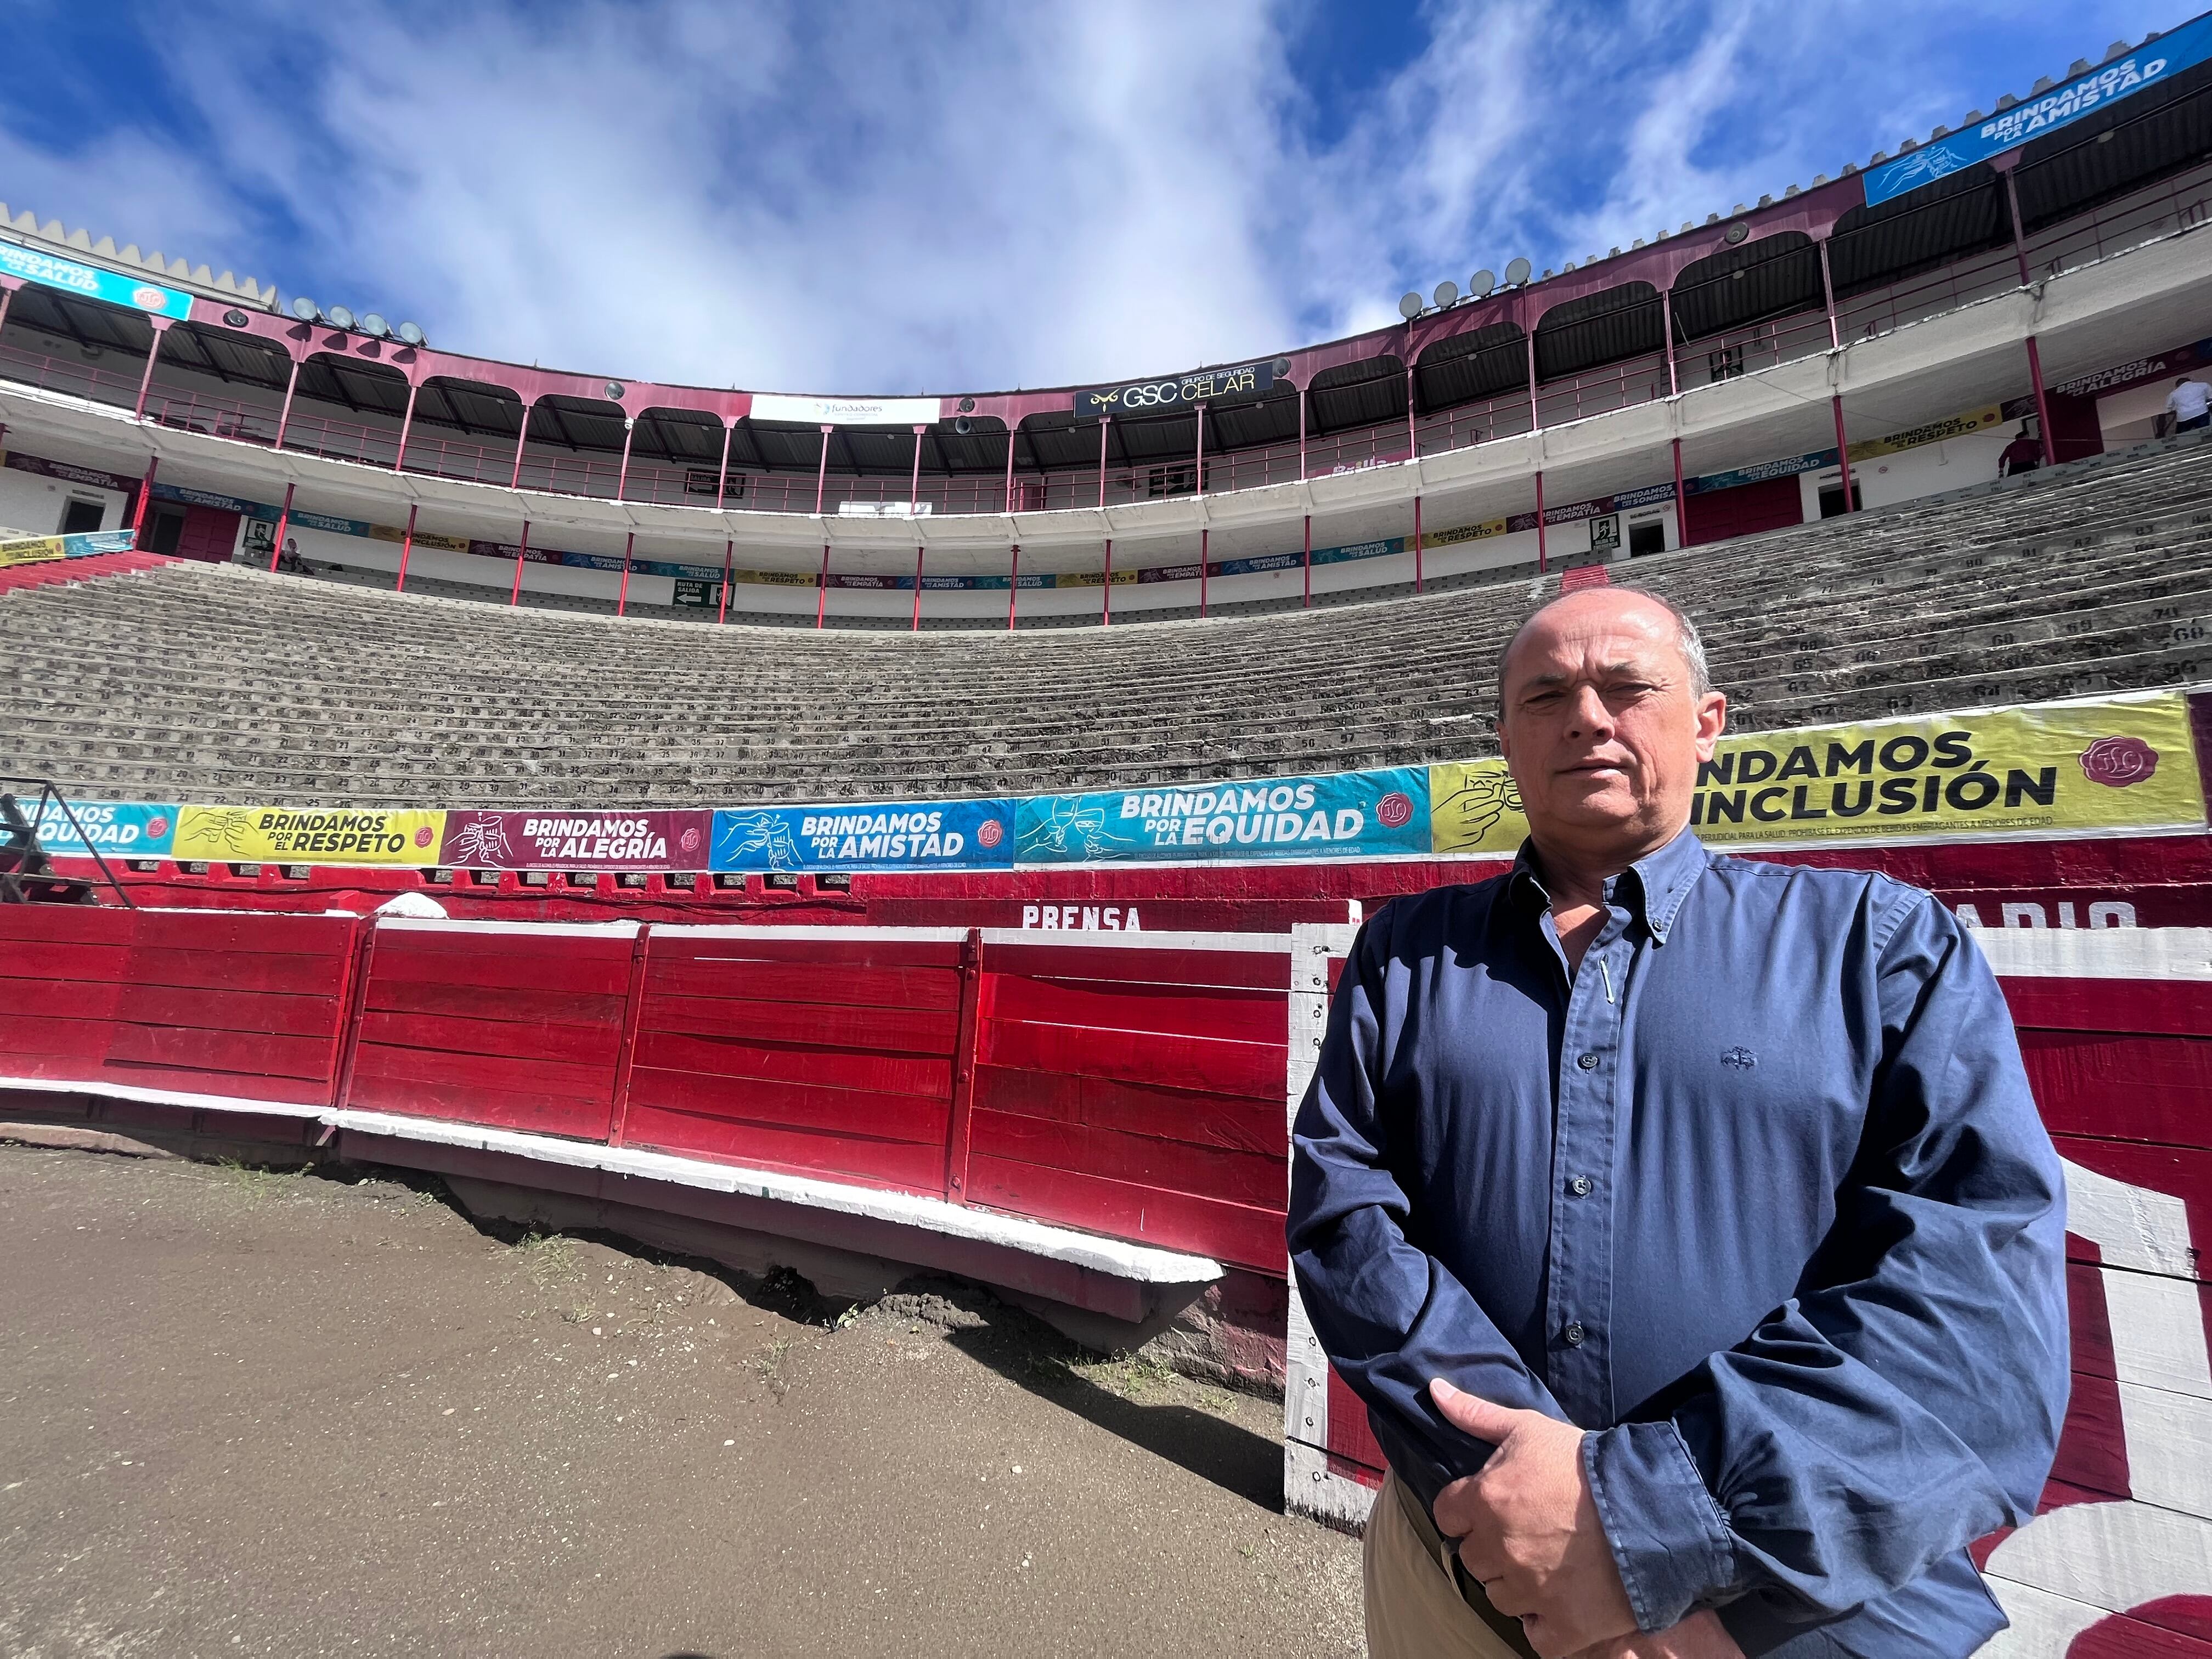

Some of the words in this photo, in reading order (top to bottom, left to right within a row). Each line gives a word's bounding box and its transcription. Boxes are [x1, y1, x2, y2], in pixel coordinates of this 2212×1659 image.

[1981, 59, 2136, 139] BRINDAMOS
[2025, 59, 2167, 133] AMISTAD
[1994, 123, 2024, 141] POR
[2004, 131, 2022, 142] LA
[25, 264, 98, 291] SALUD
[1182, 375, 1205, 385] GRUPO
[1217, 366, 1255, 379] SEGURIDAD
[2056, 359, 2147, 393] BRINDAMOS
[2087, 361, 2166, 392] ALEGRÍA
[1124, 382, 1177, 407] GSC
[1182, 374, 1254, 401] CELAR
[2067, 386, 2084, 394] POR
[832, 404, 882, 413] fundadores
[1884, 417, 1961, 444] BRINDAMOS
[1906, 421, 1977, 445] RESPETO
[49, 462, 111, 480] BRINDAMOS
[1738, 456, 1804, 476] BRINDAMOS
[1760, 459, 1820, 478] EQUIDAD
[180, 489, 235, 504] BRINDAMOS
[1613, 484, 1673, 503] BRINDAMOS
[1633, 490, 1677, 506] SONRISA
[194, 496, 241, 511] AMISTAD
[298, 513, 349, 526] BRINDAMOS
[319, 521, 351, 532] SALUD
[1433, 524, 1481, 539] BRINDAMOS
[1448, 528, 1492, 542] RESPETO
[498, 545, 541, 555] BRINDMOS
[1340, 541, 1385, 554] BRINDAMOS
[1358, 546, 1387, 556] SALUD
[1249, 555, 1290, 565] BRINDAMOS
[1261, 559, 1296, 569] AMISTAD
[679, 566, 718, 574] BRINDAMOS
[1163, 566, 1201, 574] BRINDAMOS
[1175, 570, 1203, 578] EMPATÍ
[1091, 576, 1126, 584] RESETO
[1695, 731, 1973, 788] NDAMOS
[1692, 759, 2058, 825] INCLUSIÓN
[1120, 785, 1316, 819] BRINDAMOS
[16, 804, 116, 823] NDAMOS
[259, 814, 386, 832] BRINDAMOS
[523, 818, 649, 837] BRINDAMOS
[801, 811, 943, 836] BRINDAMOS
[1144, 819, 1181, 833] POR
[1182, 809, 1364, 845] EQUIDAD
[1701, 832, 1738, 841] PERJUDICIAL
[1912, 820, 1968, 831] EMBRIAGANTES
[1979, 819, 2016, 827] MENORES
[2017, 818, 2029, 826] DE
[2030, 816, 2053, 826] EDAD
[27, 823, 139, 843] QUIDAD
[267, 832, 292, 841] POR
[1154, 832, 1178, 846] LA
[274, 841, 288, 850] EL
[292, 833, 405, 853] RESPETO
[535, 838, 560, 848] POR
[559, 831, 668, 859] ALEGRÍA
[811, 837, 838, 848] POR
[838, 833, 964, 859] AMISTAD
[541, 848, 556, 857] LA
[818, 848, 835, 859] LA
